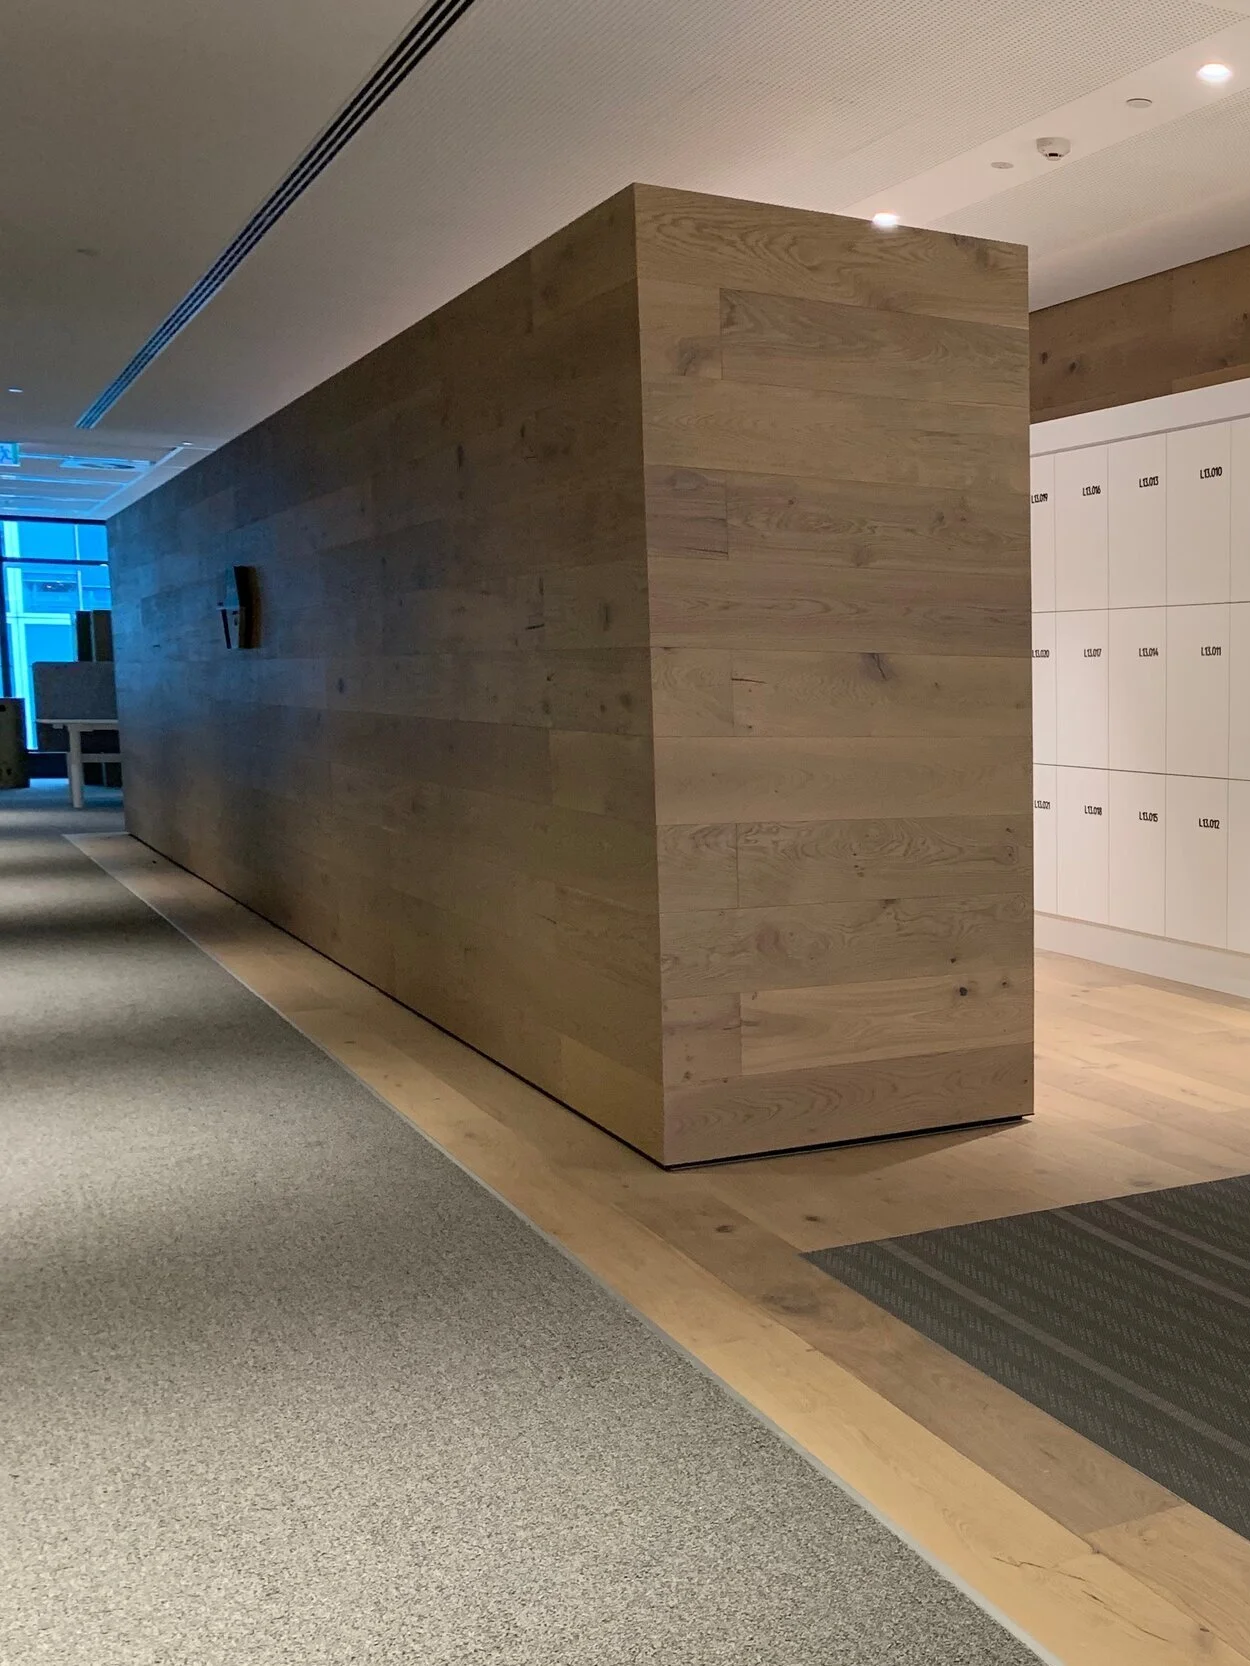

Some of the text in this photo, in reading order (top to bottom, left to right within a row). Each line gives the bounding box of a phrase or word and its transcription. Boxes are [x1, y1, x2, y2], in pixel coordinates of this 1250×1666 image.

[1200, 466, 1222, 479] L13.010
[1139, 476, 1159, 488] L13.013
[1201, 647, 1221, 656] L13.011
[1139, 812, 1158, 822] L13.015
[1199, 818, 1220, 829] L13.012
